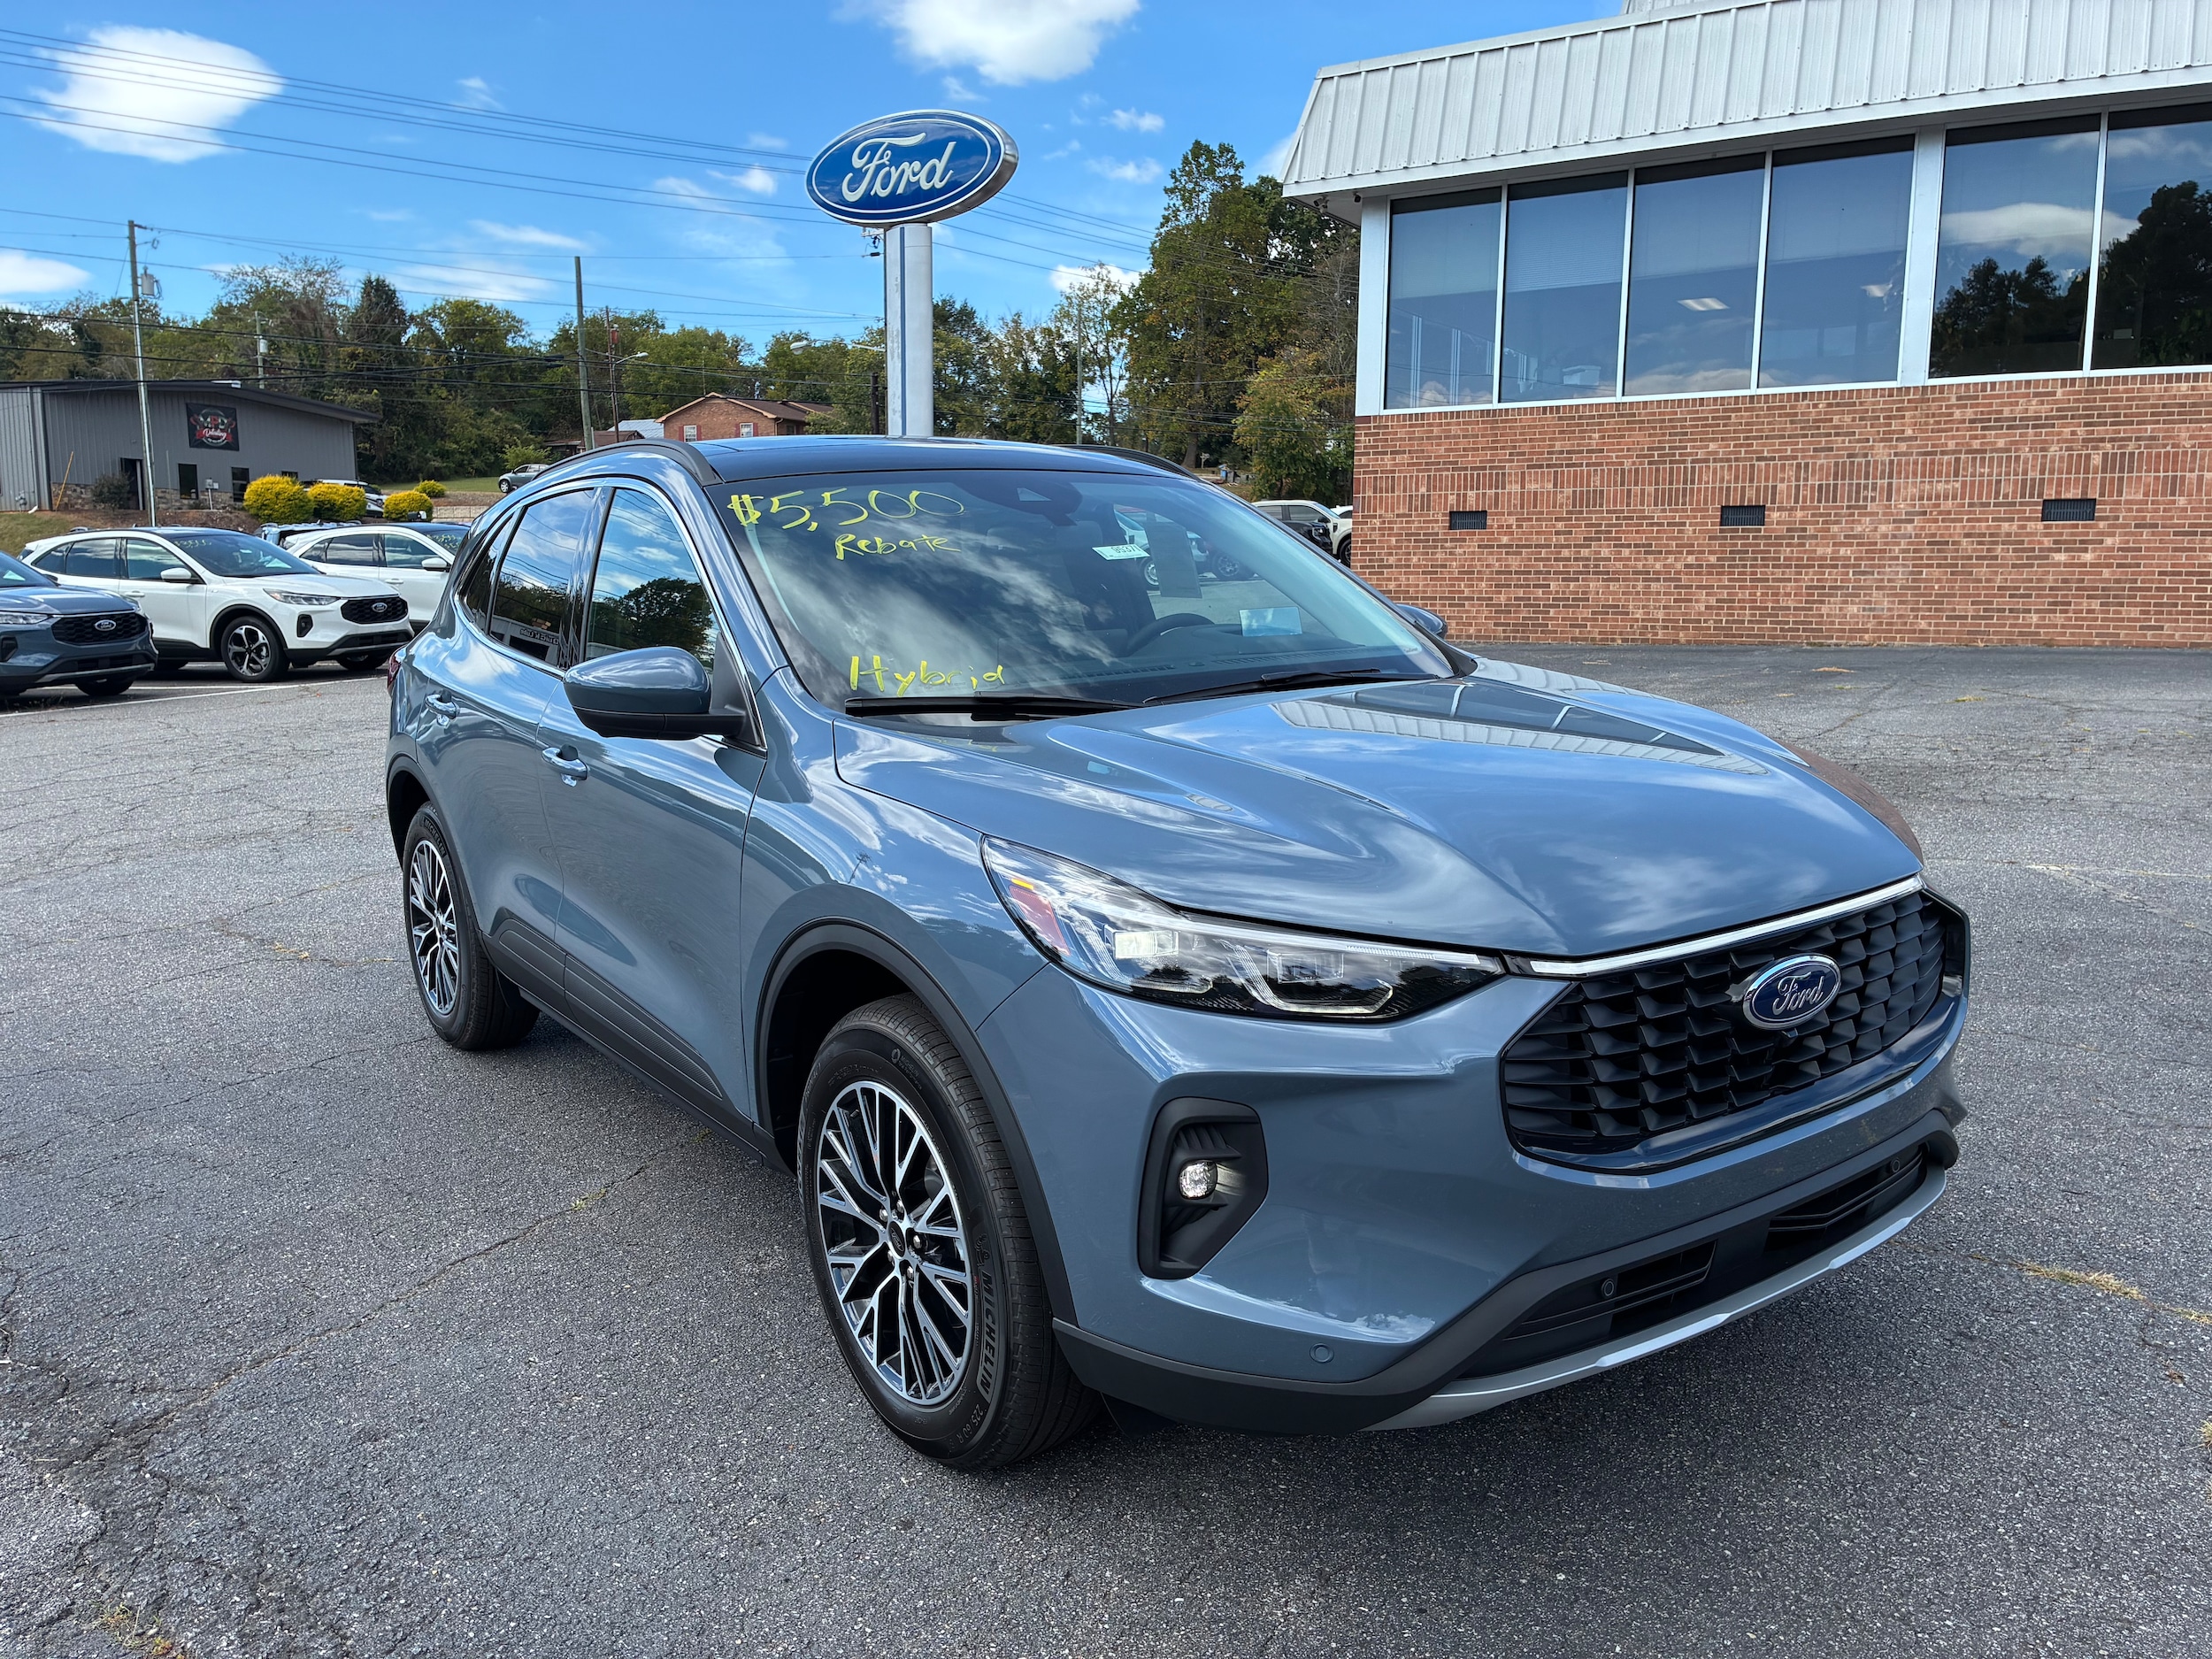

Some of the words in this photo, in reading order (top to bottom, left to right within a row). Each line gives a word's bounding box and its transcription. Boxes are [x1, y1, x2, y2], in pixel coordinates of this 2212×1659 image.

[842, 133, 956, 202] Ford
[727, 488, 966, 531] $5,500
[834, 534, 962, 560] Rebate
[849, 656, 1005, 697] Hybrid
[424, 819, 446, 855] MICHELIN
[1772, 972, 1824, 1015] Ford
[981, 1271, 996, 1395] MICHELIN
